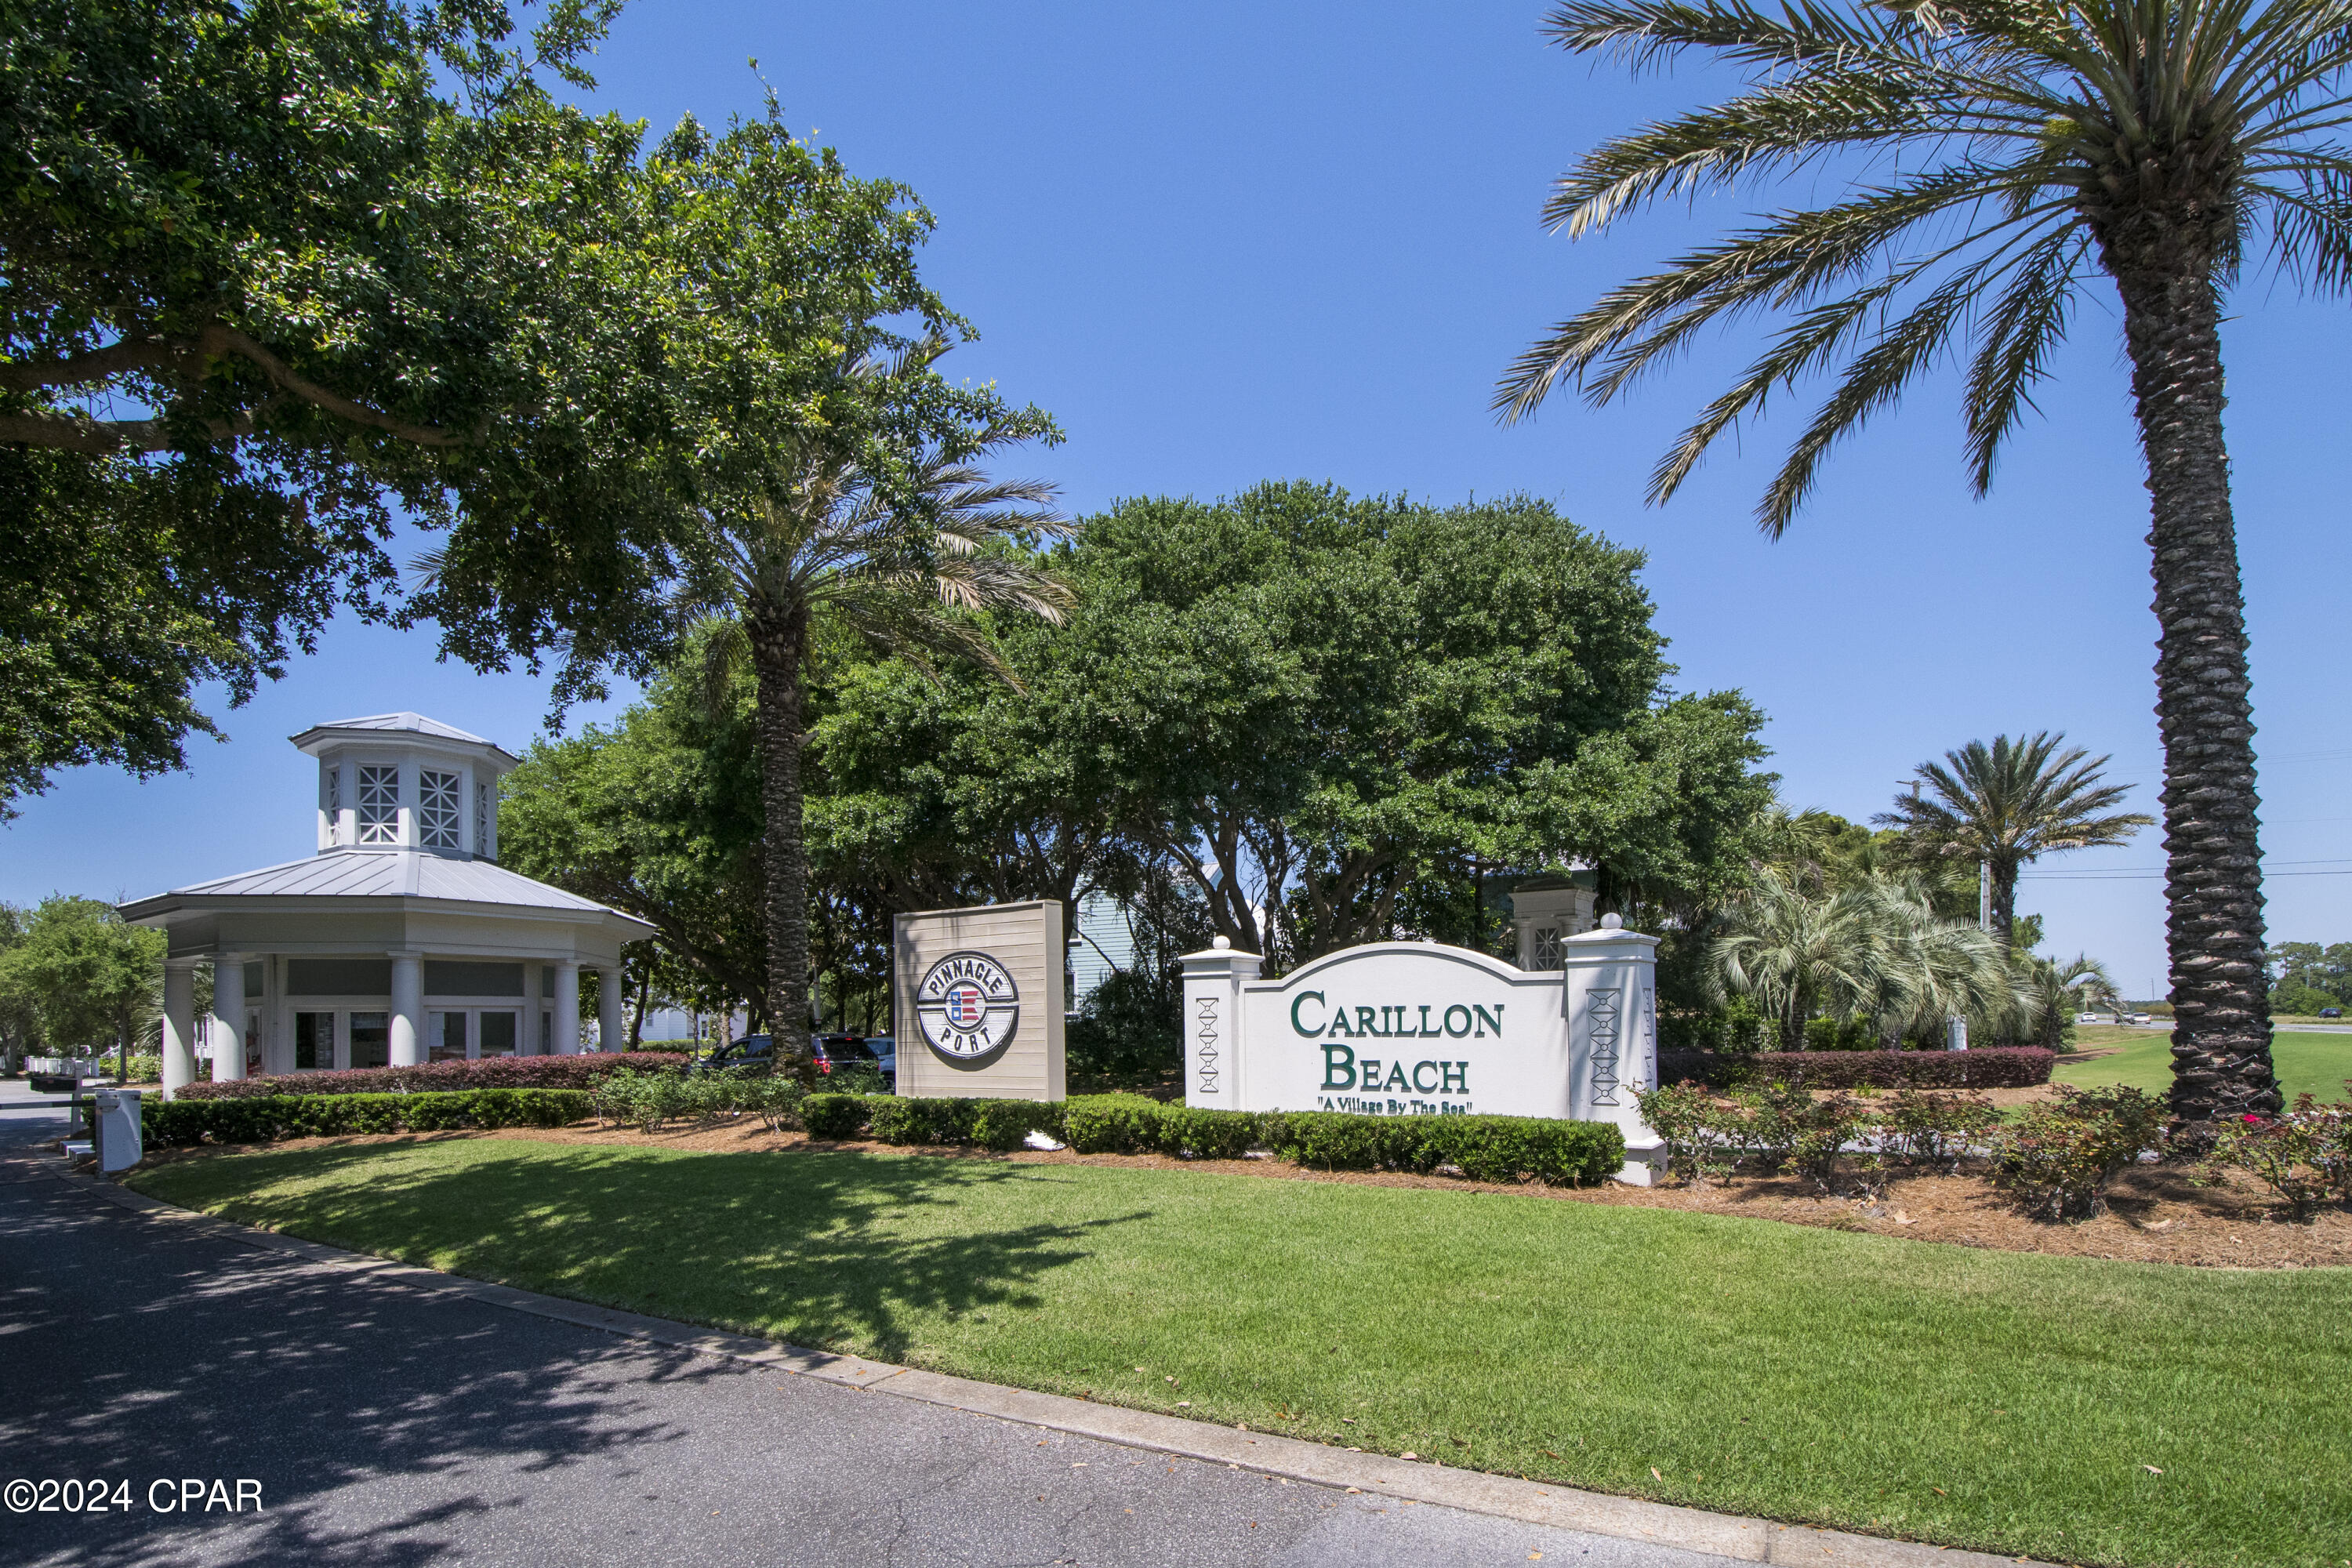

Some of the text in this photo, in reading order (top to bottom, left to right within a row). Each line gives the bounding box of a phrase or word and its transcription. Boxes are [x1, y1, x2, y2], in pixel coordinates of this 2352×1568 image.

[929, 959, 1004, 996] PINNACLE
[1290, 990, 1504, 1039] CARILLON
[941, 1027, 993, 1053] PORT
[1319, 1044, 1470, 1093] BEACH
[1338, 1098, 1382, 1114] Village
[1387, 1099, 1406, 1115] By
[1410, 1100, 1436, 1115] The
